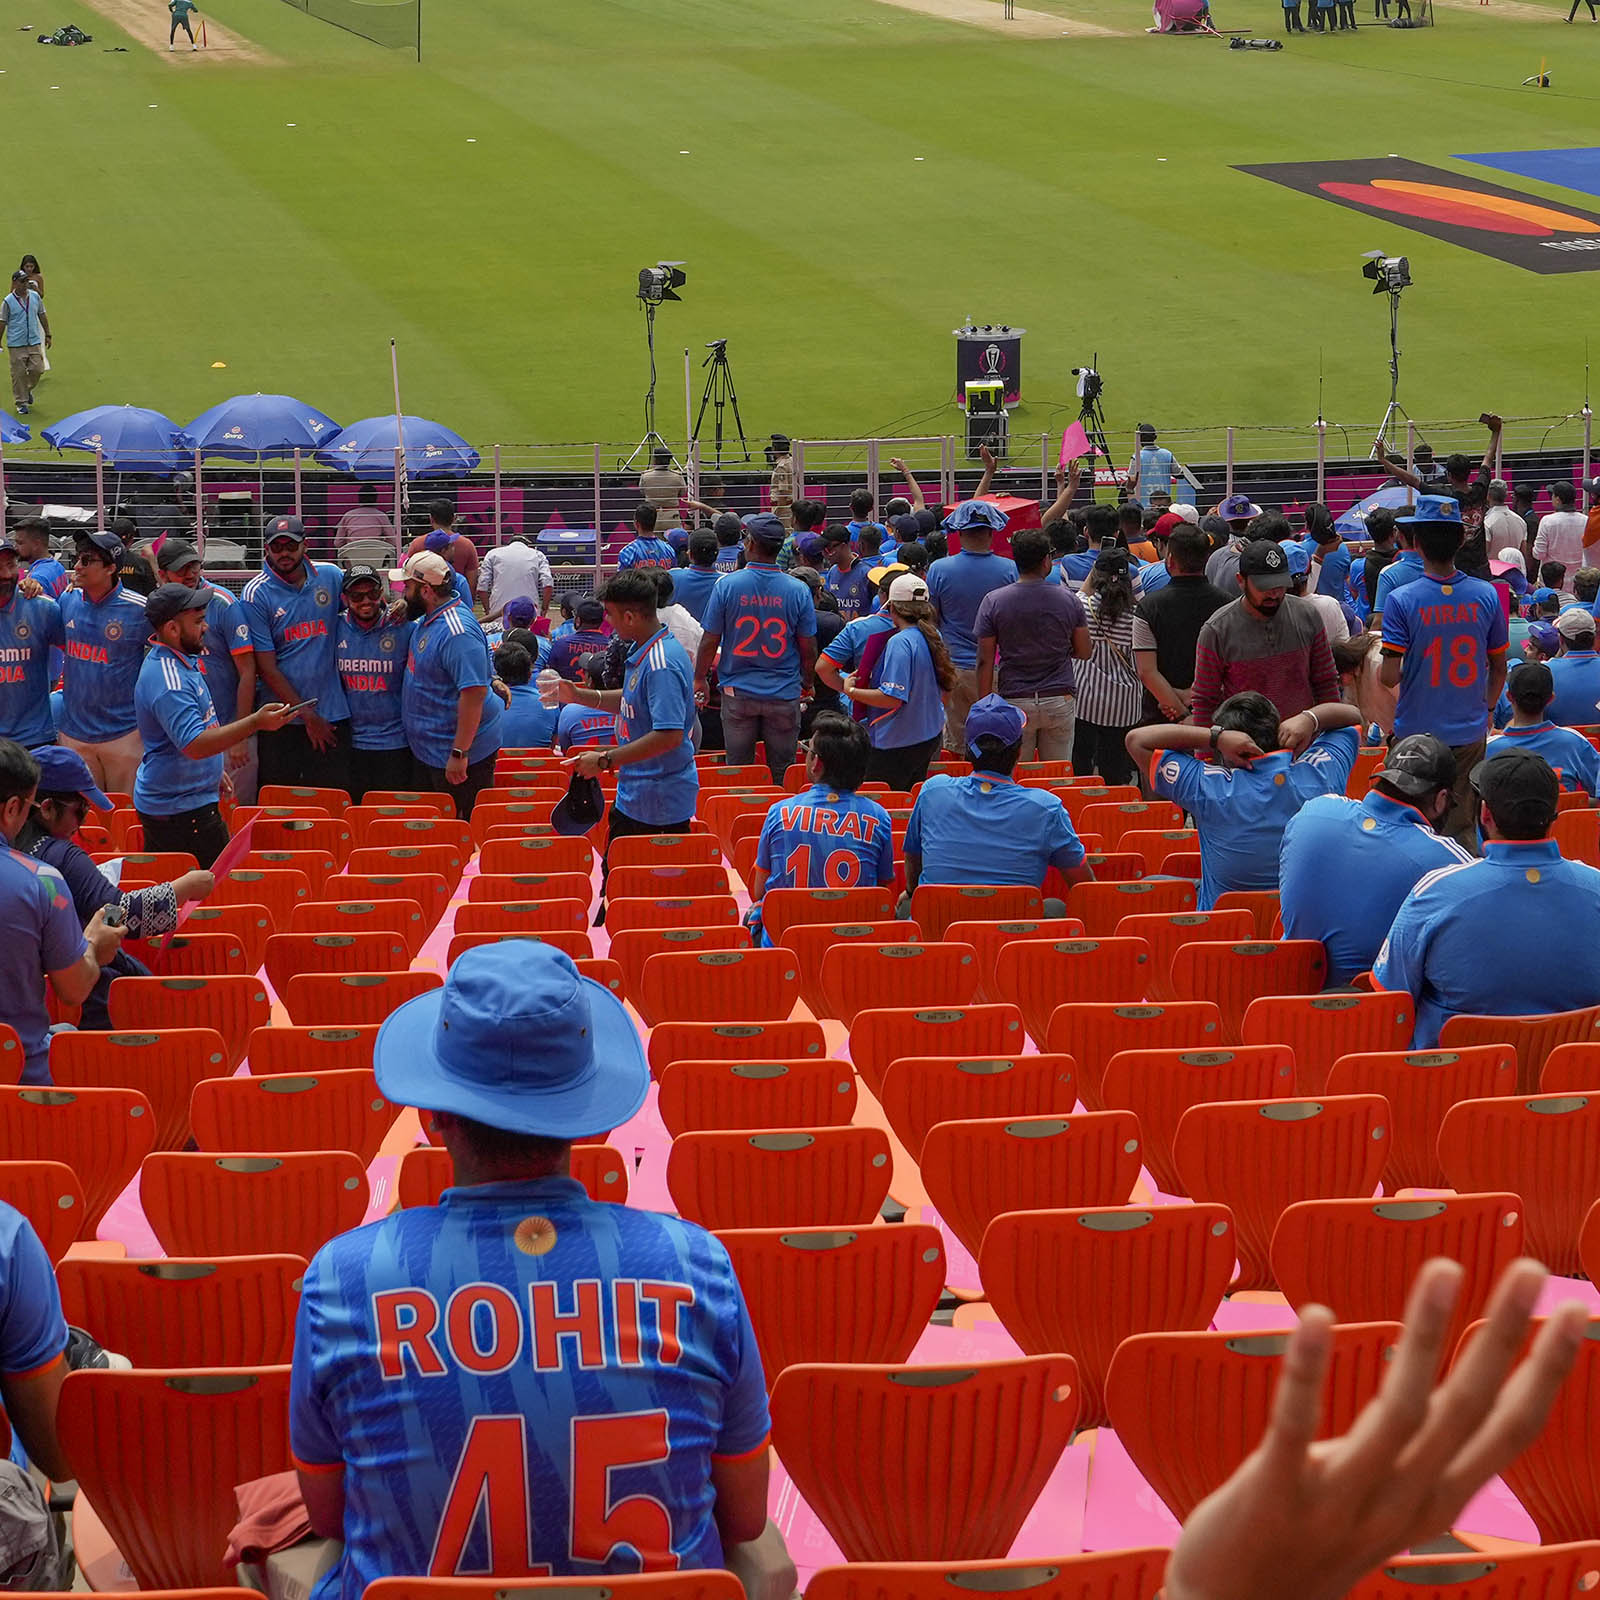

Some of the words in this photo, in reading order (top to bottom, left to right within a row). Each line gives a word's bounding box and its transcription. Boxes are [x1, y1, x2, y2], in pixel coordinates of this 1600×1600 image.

[739, 595, 783, 609] SAMIR
[1419, 602, 1480, 626] VIRAT
[283, 618, 328, 643] INDIA
[733, 615, 788, 659] 23
[66, 639, 109, 665] INDIA
[1422, 634, 1479, 689] 18
[580, 715, 616, 731] VIRA
[780, 805, 880, 844] VIRAT
[371, 1277, 696, 1382] ROHIT
[427, 1408, 681, 1577] 45
